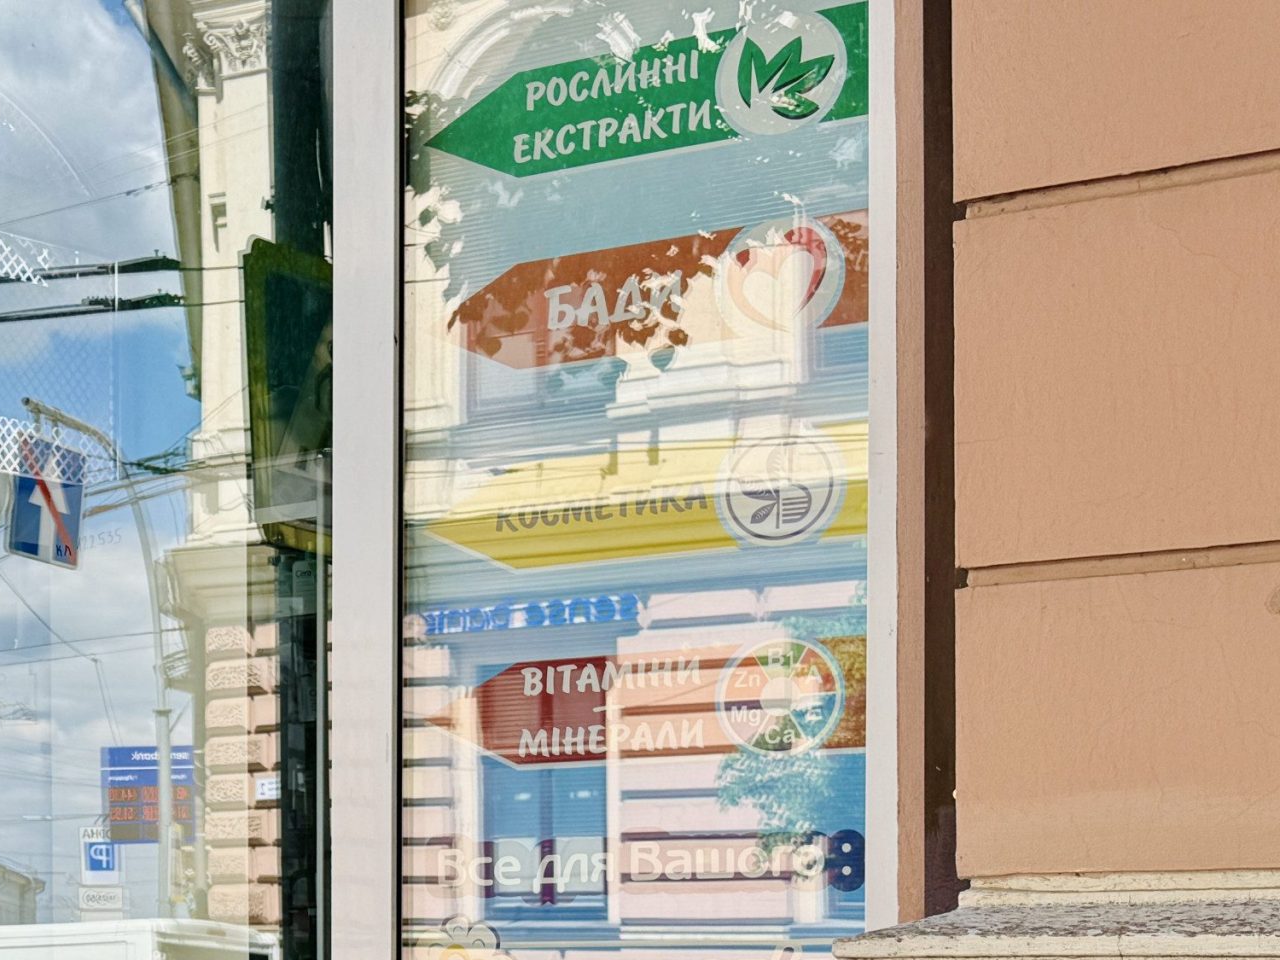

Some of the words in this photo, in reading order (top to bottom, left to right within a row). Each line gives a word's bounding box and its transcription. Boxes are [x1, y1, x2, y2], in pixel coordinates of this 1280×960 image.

[526, 49, 699, 111] РОСЛИННІ
[513, 99, 712, 163] ЕКСТРАКТИ
[522, 655, 701, 697] ВІТАМІНИ
[734, 671, 760, 688] Zn
[730, 706, 762, 725] Mg
[764, 725, 796, 744] Ca
[519, 719, 704, 757] МІНЕРАЛИ
[438, 849, 522, 887] Все
[533, 851, 614, 894] для
